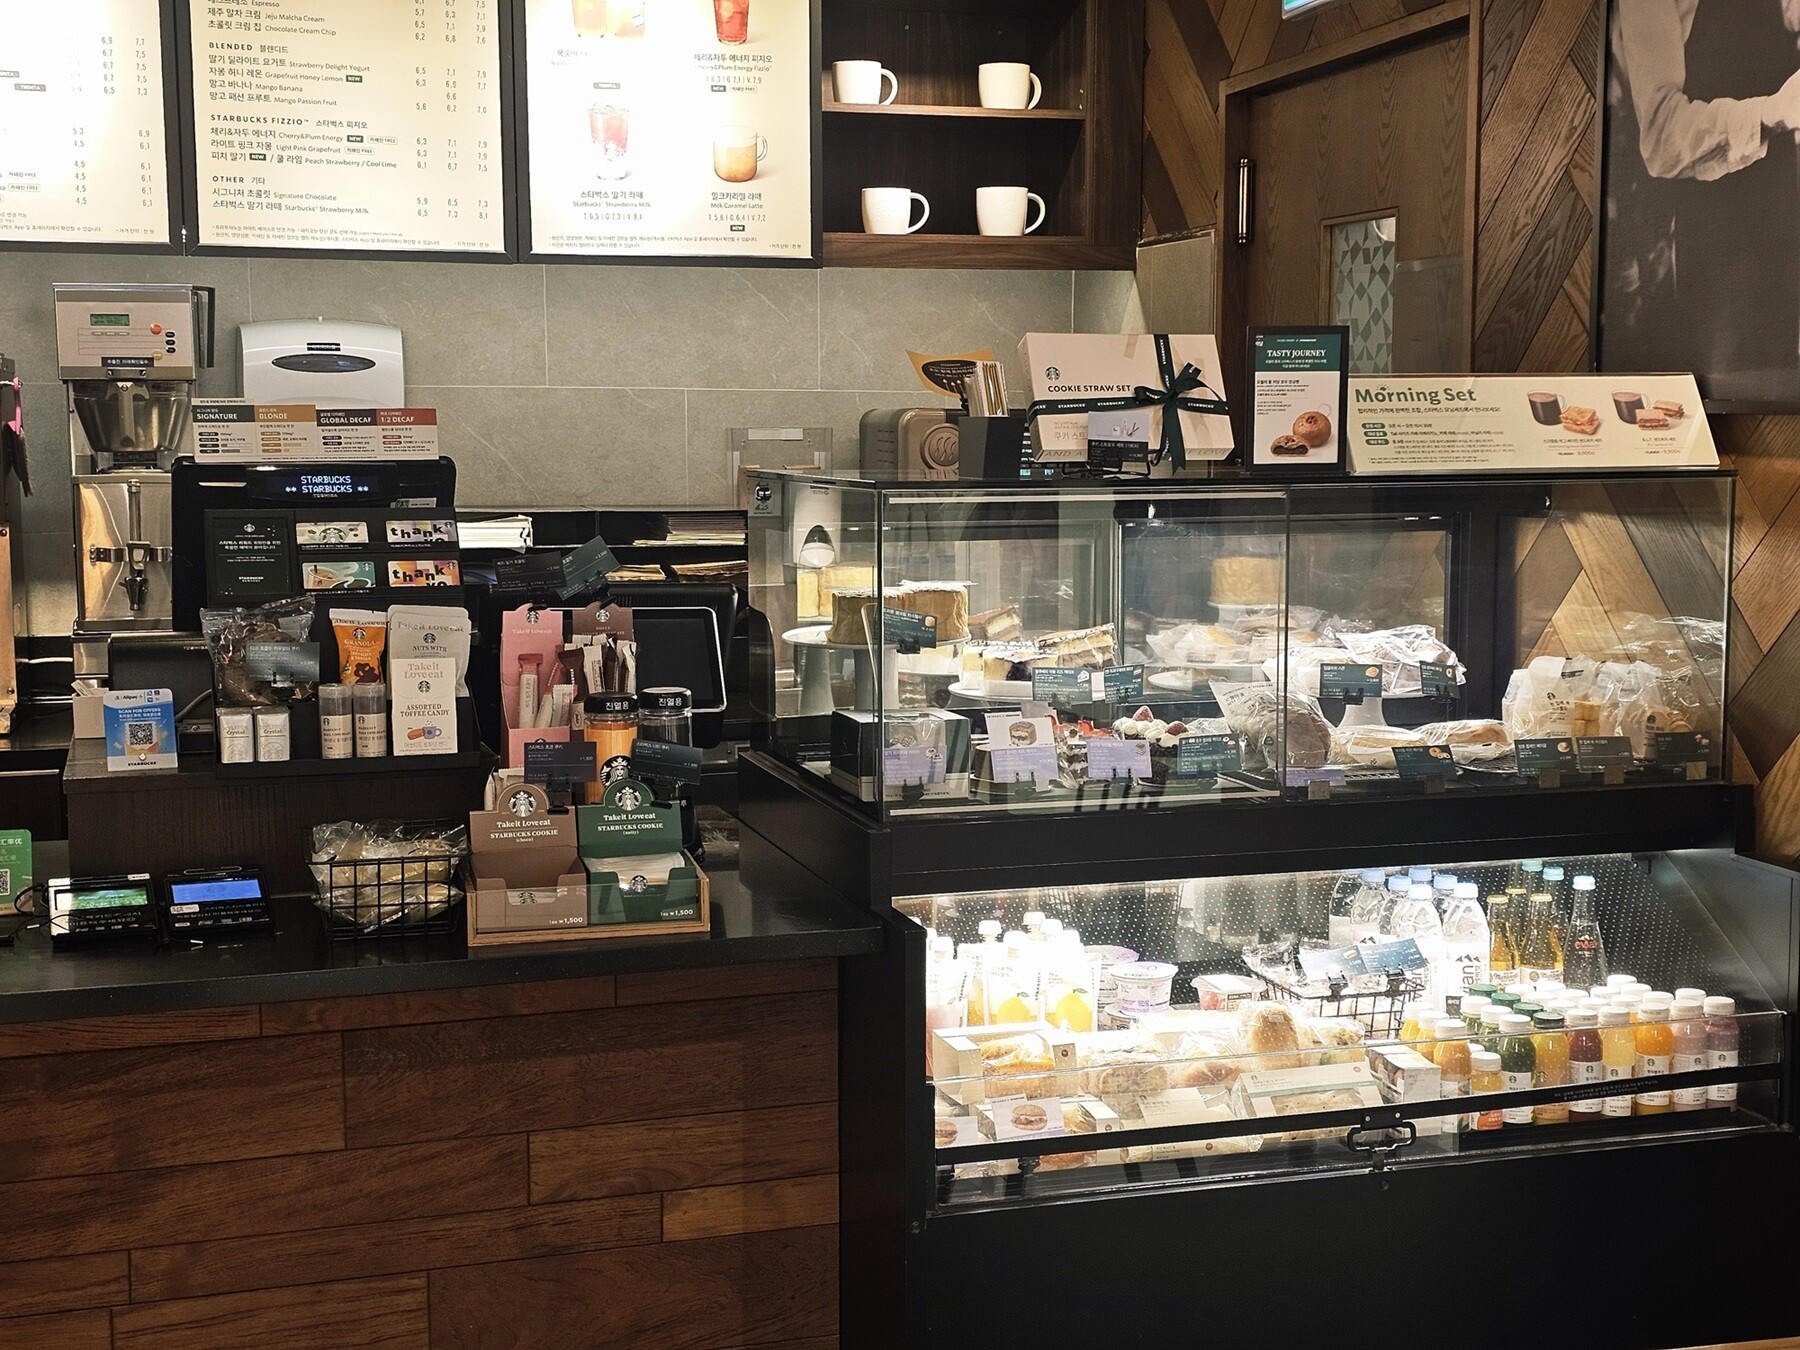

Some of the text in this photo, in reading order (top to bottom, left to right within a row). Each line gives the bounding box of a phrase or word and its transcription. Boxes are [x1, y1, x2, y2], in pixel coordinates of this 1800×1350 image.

[251, 0, 280, 8] Espresso
[208, 8, 224, 16] 제주
[226, 9, 242, 18] 말차
[245, 10, 261, 19] 크림
[208, 20, 232, 30] 초콜릿
[235, 22, 251, 31] 크림
[254, 23, 261, 32] 칩
[265, 25, 298, 33] Chocolate
[321, 28, 336, 36] Chip
[209, 42, 289, 53] BLENDED 블렌디드
[209, 55, 370, 73] 딸기 딜라이트 요거트 Strawberry Delight Yogurt
[729, 54, 773, 63] 에너지 피지오
[209, 67, 225, 76] 자몽
[228, 68, 244, 78] 허니
[246, 69, 262, 79] 레몬
[265, 72, 299, 81] Grapefruit
[300, 73, 320, 83] Honey
[209, 79, 303, 92] 망고 바나나 Mango Banana
[209, 91, 337, 106] 망고 패션 프루트 Mango Passion Fruit
[211, 115, 267, 123] STARBUCKS
[315, 120, 344, 128] 스타벅스
[346, 121, 367, 129] 피지오
[211, 127, 249, 137] 체리&자두
[251, 129, 276, 139] 에너지
[278, 132, 321, 142] Cherry&Plum
[322, 134, 343, 143] Energy
[211, 139, 235, 148] 라이트
[238, 141, 254, 150] 핑크
[256, 142, 272, 151] 자몽
[276, 144, 293, 153] Light
[308, 146, 341, 154] Grapefruit
[212, 152, 227, 161] 피치
[230, 152, 246, 162] 딸기
[287, 156, 303, 164] 라임
[305, 158, 324, 166] Peach
[326, 159, 360, 168] Strawberry
[251, 177, 265, 185] 기타
[212, 188, 337, 201] 시그니처 초콜릿 Signature Chocolate
[580, 191, 609, 199] 스타벅스
[212, 200, 370, 214] 스타벅스 딸기 라떼 Strawberry Milk
[1291, 350, 1326, 358] JOURNEY
[1047, 384, 1131, 393] COOKIE STRAW SET
[1355, 386, 1477, 405] Morning Set
[301, 475, 351, 484] STARBUCKS
[302, 485, 352, 493] STARBUCKS
[391, 524, 444, 539] thank
[393, 565, 445, 582] thank
[344, 639, 376, 647] GRANOLA
[606, 701, 629, 711] 진열용
[659, 697, 682, 706] 진열용
[597, 822, 664, 832] STARBUCKS COOKIE
[490, 829, 558, 839] STARBUCKS COOKIE
